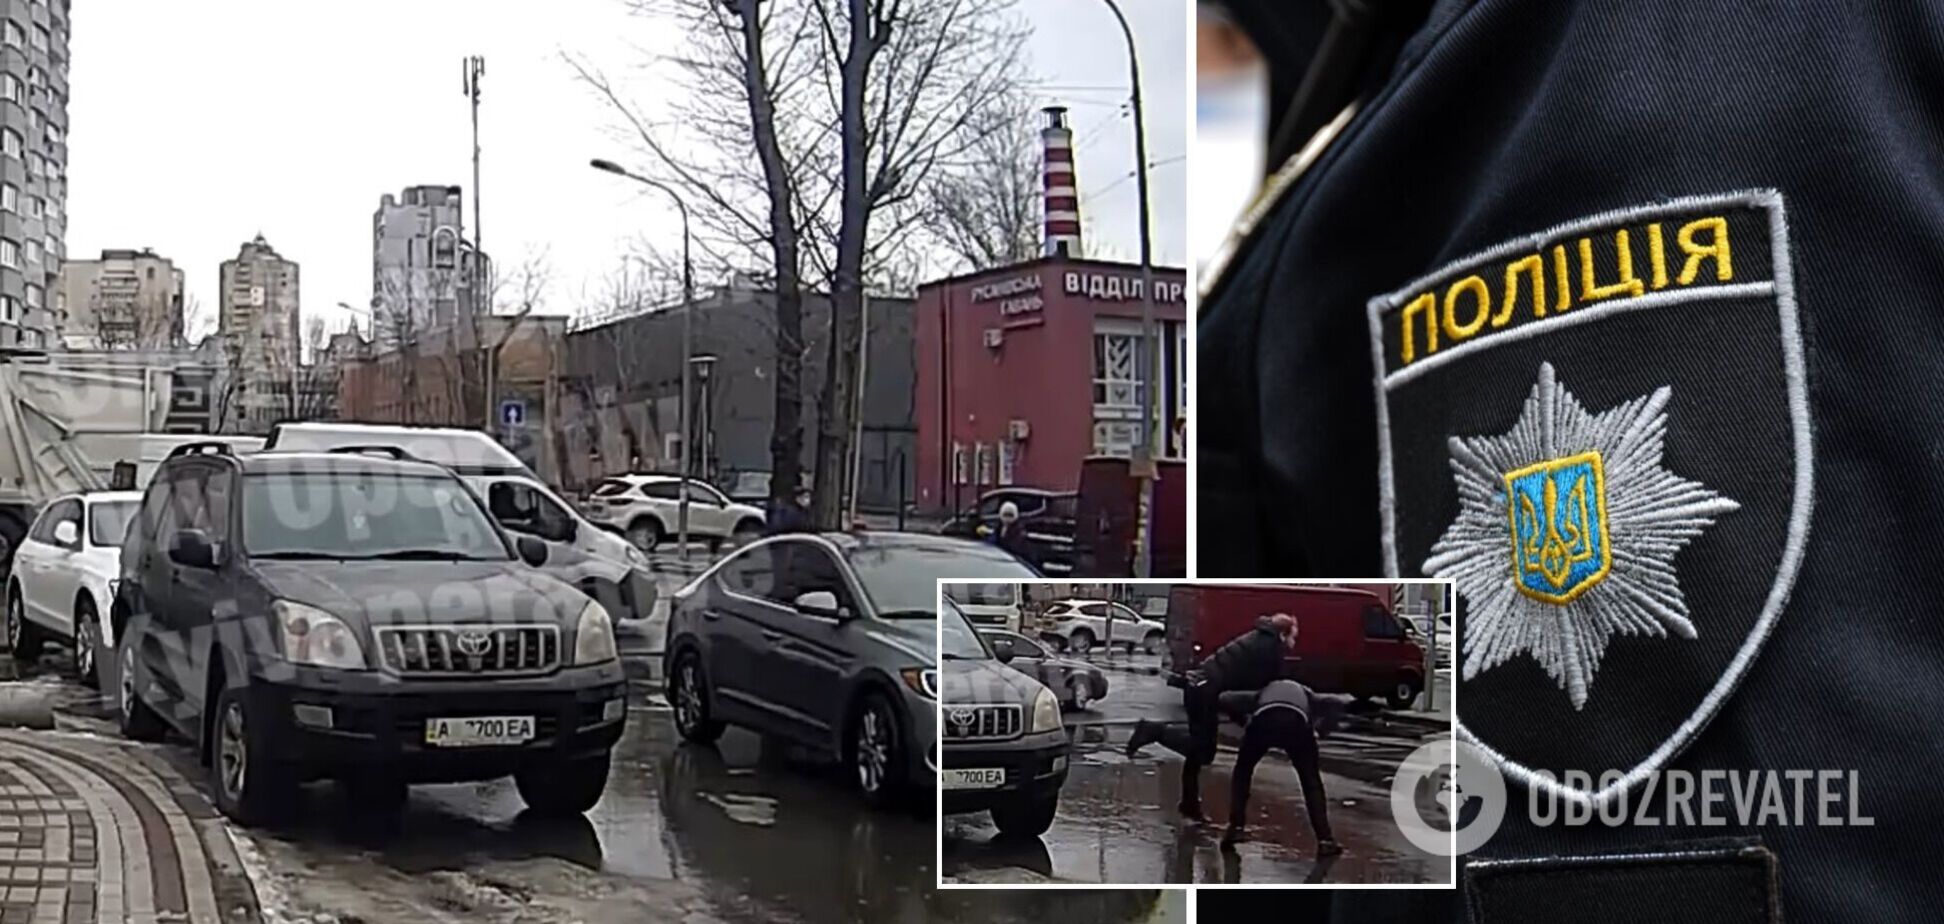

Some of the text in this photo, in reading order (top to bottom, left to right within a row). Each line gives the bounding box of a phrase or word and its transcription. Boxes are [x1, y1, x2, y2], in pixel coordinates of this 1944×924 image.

[1065, 272, 1144, 300] ВІДДІЛ
[1400, 216, 1733, 364] ПОЛІЦІЯ
[507, 719, 531, 737] EA
[985, 770, 1002, 784] EA
